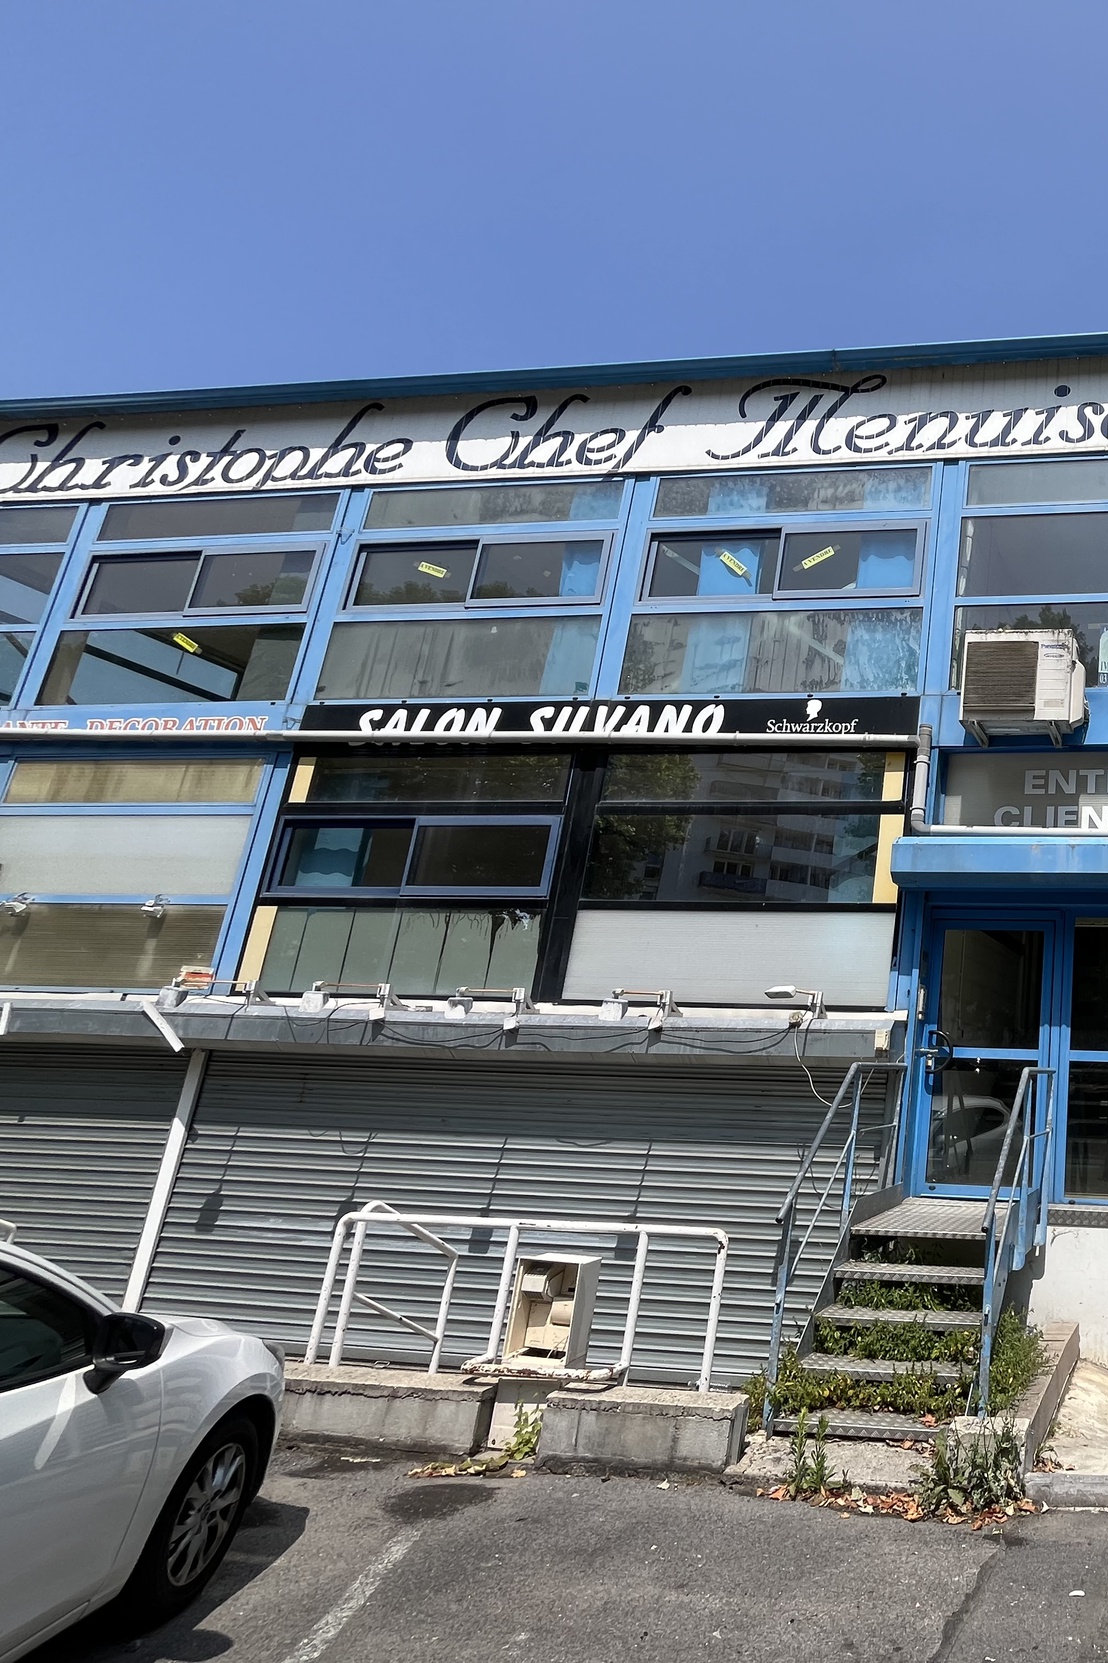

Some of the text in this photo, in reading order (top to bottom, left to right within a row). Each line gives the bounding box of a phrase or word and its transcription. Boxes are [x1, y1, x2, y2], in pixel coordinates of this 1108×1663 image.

[446, 385, 692, 482] Chef
[1099, 673, 1107, 684] 03
[359, 707, 502, 732] SALON
[766, 719, 858, 734] Schwarzkopf
